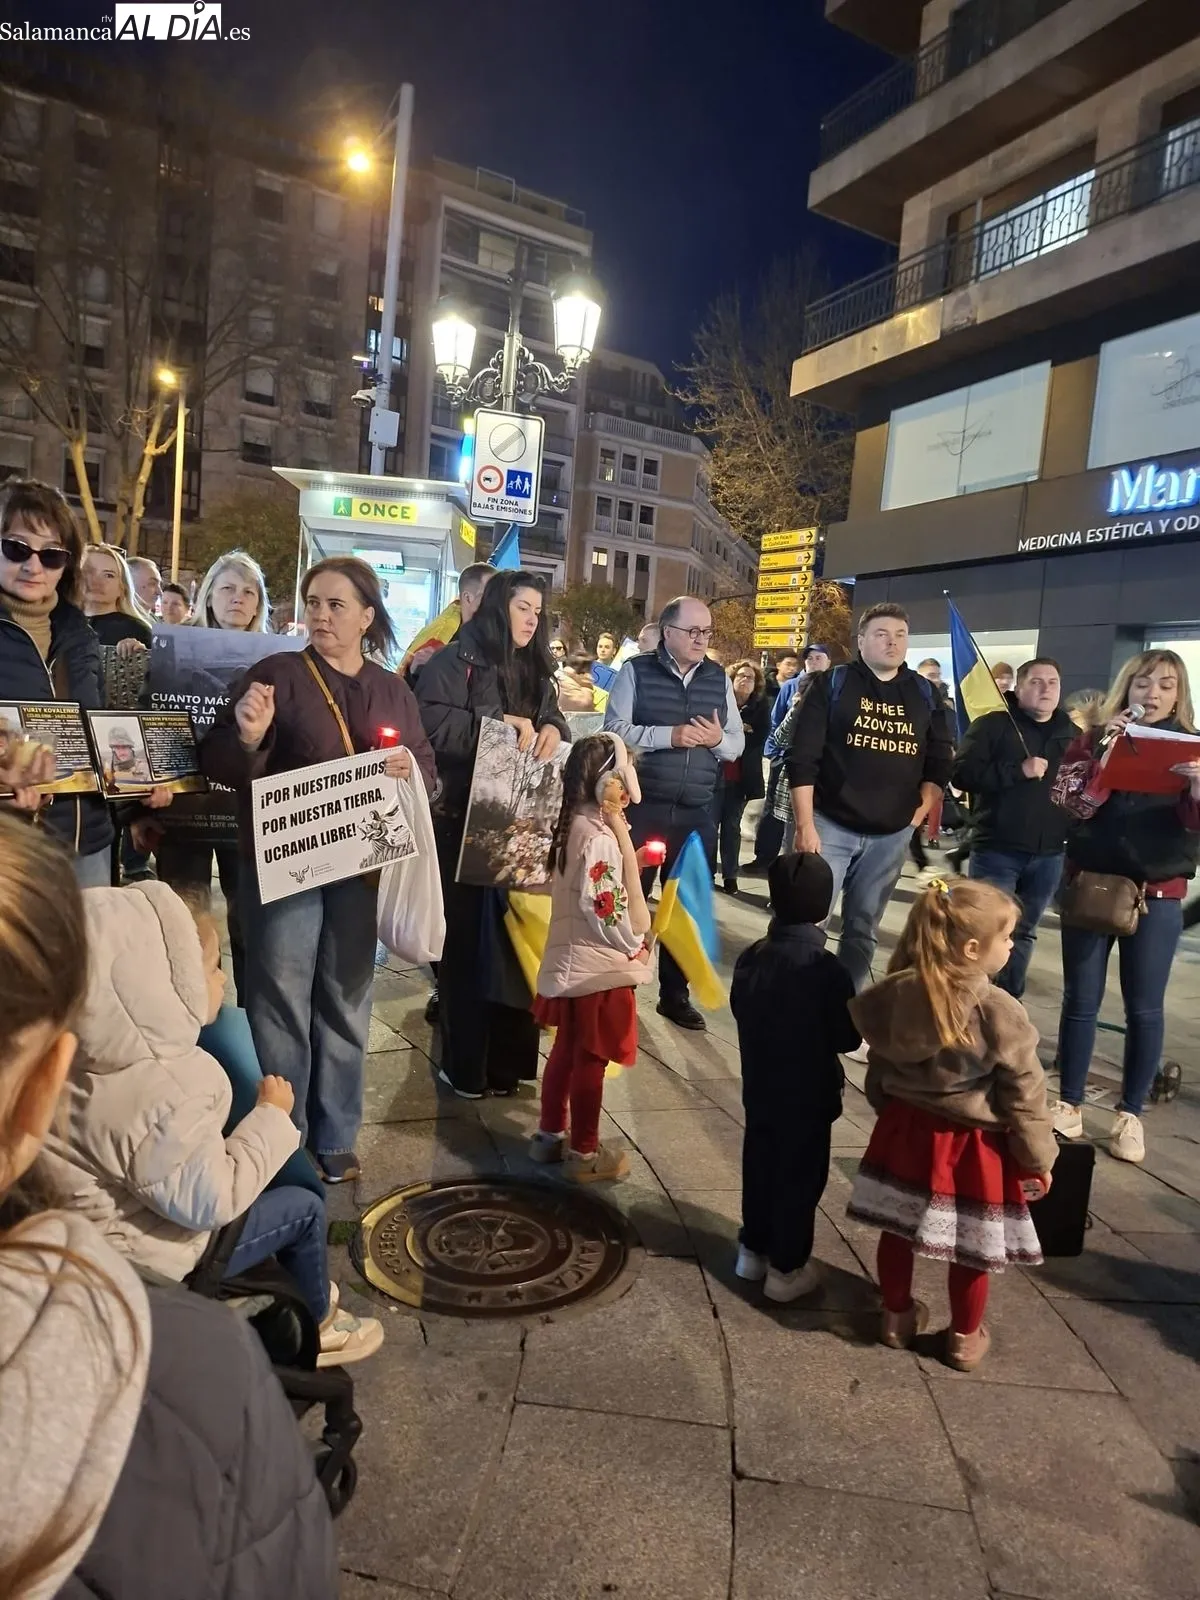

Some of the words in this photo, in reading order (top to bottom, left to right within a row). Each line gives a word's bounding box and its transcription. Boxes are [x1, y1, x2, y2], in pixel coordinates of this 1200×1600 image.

[359, 502, 411, 520] ONCE
[472, 501, 494, 511] BAJAS
[496, 504, 533, 516] EMISIONES
[500, 498, 519, 506] ZONA
[1018, 531, 1082, 551] MEDICINA
[1086, 520, 1153, 543] ESTÉTICA
[1159, 518, 1171, 533] Y
[151, 692, 201, 704] CUANTO
[204, 695, 231, 706] MÁS
[202, 706, 217, 715] LA
[876, 703, 905, 716] FREE
[854, 715, 915, 736] AZOVSTAL
[847, 733, 918, 755] DEFENDERS
[261, 787, 290, 809] ¡POR
[293, 769, 353, 799] NUESTROS
[262, 815, 287, 836] POR
[290, 799, 342, 828] NUESTRA
[344, 787, 386, 811] TIERRA,
[264, 834, 319, 864] UCRANIA
[321, 822, 357, 846] LIBRE!
